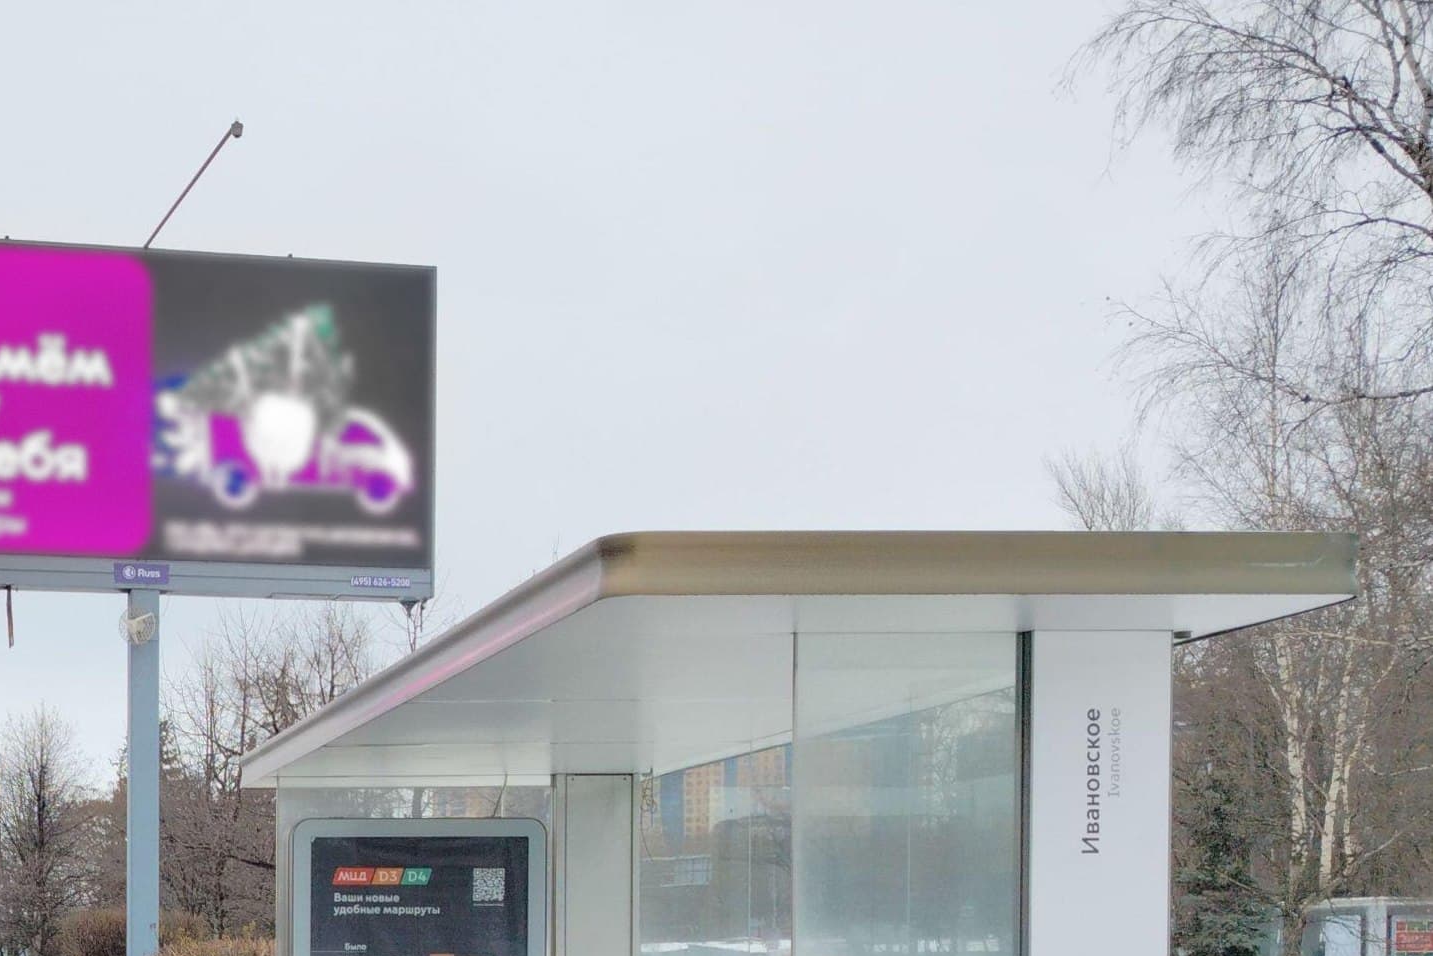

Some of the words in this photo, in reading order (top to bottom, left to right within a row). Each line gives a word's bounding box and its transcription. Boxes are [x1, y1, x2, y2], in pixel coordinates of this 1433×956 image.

[137, 568, 161, 578] Russ
[350, 575, 372, 587] (495)
[1107, 707, 1122, 798] Ivanovskoe
[1081, 708, 1101, 854] Ивановское
[337, 870, 367, 881] МЦД
[378, 871, 398, 882] D3
[407, 871, 427, 882] D4
[333, 892, 364, 903] Ваши
[365, 895, 401, 903] новые
[332, 904, 381, 916] удобные
[382, 906, 441, 917] маршруты
[344, 942, 367, 951] Было
